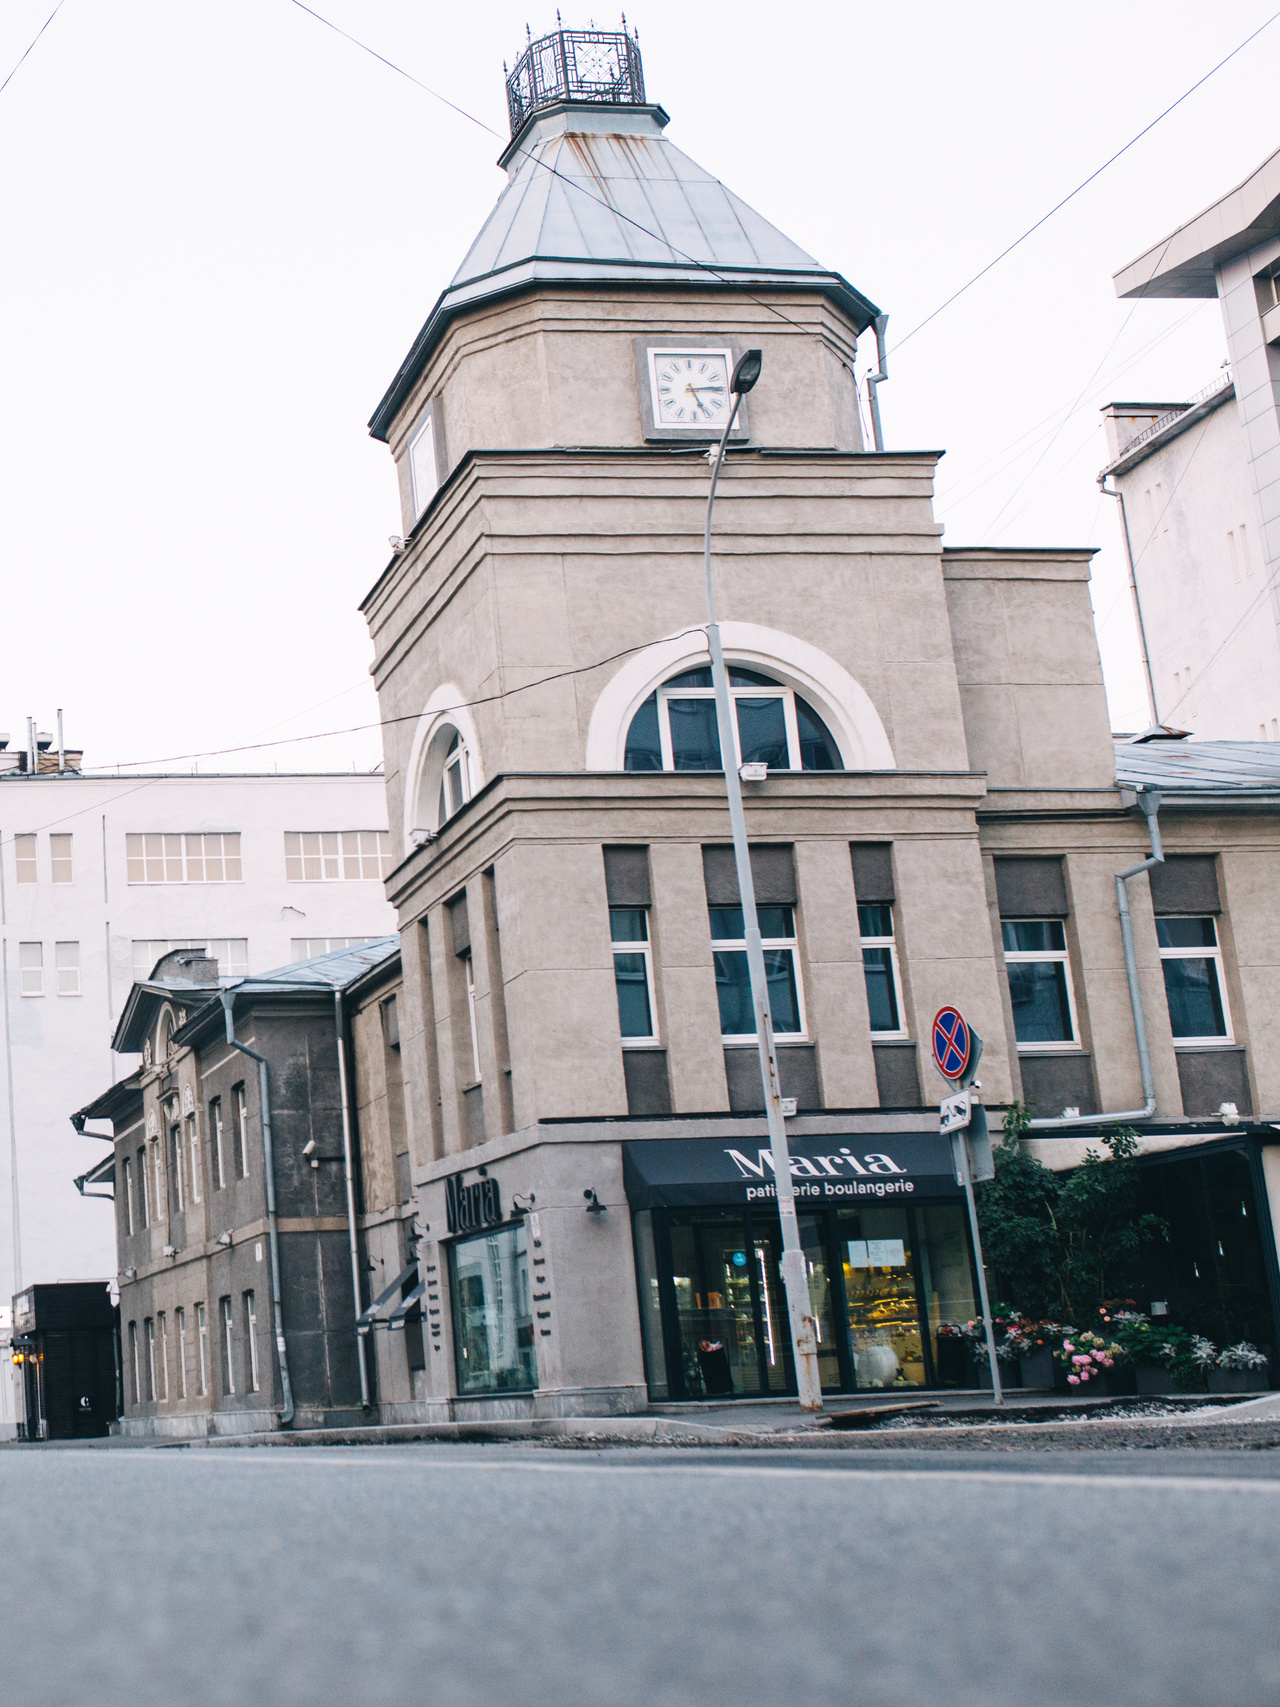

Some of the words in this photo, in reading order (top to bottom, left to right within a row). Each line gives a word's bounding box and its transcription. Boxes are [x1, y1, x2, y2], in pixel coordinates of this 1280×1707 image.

[723, 1147, 907, 1178] Maria
[445, 1165, 502, 1234] Maria
[746, 1182, 820, 1200] patierie
[824, 1179, 914, 1196] boulangerie
